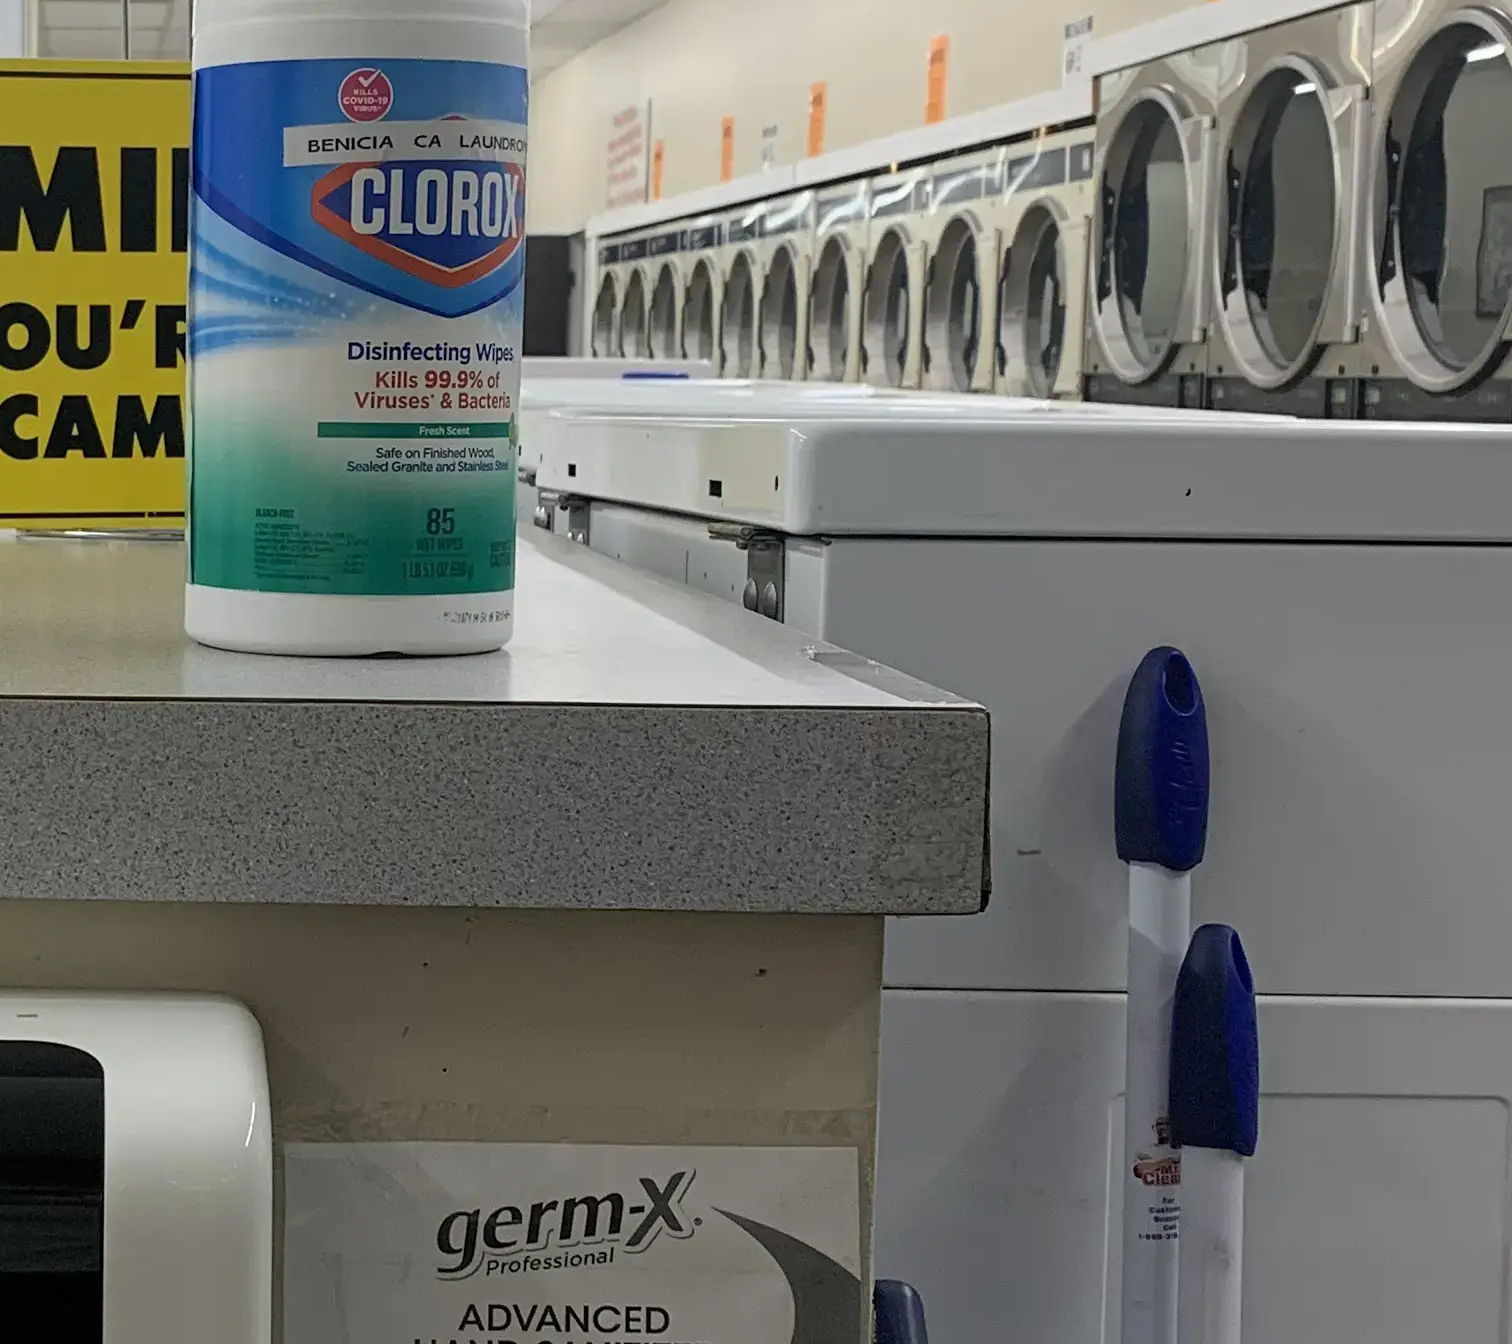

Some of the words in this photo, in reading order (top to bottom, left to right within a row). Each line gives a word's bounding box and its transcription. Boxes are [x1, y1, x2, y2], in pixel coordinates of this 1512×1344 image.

[343, 96, 388, 105] COVID-19
[353, 88, 378, 96] KILLS
[308, 135, 394, 153] BENICIA
[414, 134, 441, 148] CA
[351, 168, 519, 238] CLOROX
[348, 342, 471, 364] Disinfecting
[476, 343, 514, 364] Wipes
[375, 371, 418, 389] Kills
[424, 370, 483, 389] 99.9%
[487, 371, 500, 389] of
[440, 392, 452, 409] &
[458, 392, 510, 409] Bacteria
[419, 426, 445, 435] Fresh
[446, 426, 470, 435] Scent
[376, 447, 402, 459] Safe
[405, 449, 420, 459] on
[423, 447, 466, 459] Finished
[347, 460, 388, 472] Sealed
[391, 461, 433, 473] Granite
[435, 461, 455, 472] and
[458, 461, 493, 472] Stainless
[426, 507, 455, 535] 85
[487, 1247, 614, 1276] Professional
[459, 1304, 670, 1334] ADVANCED
